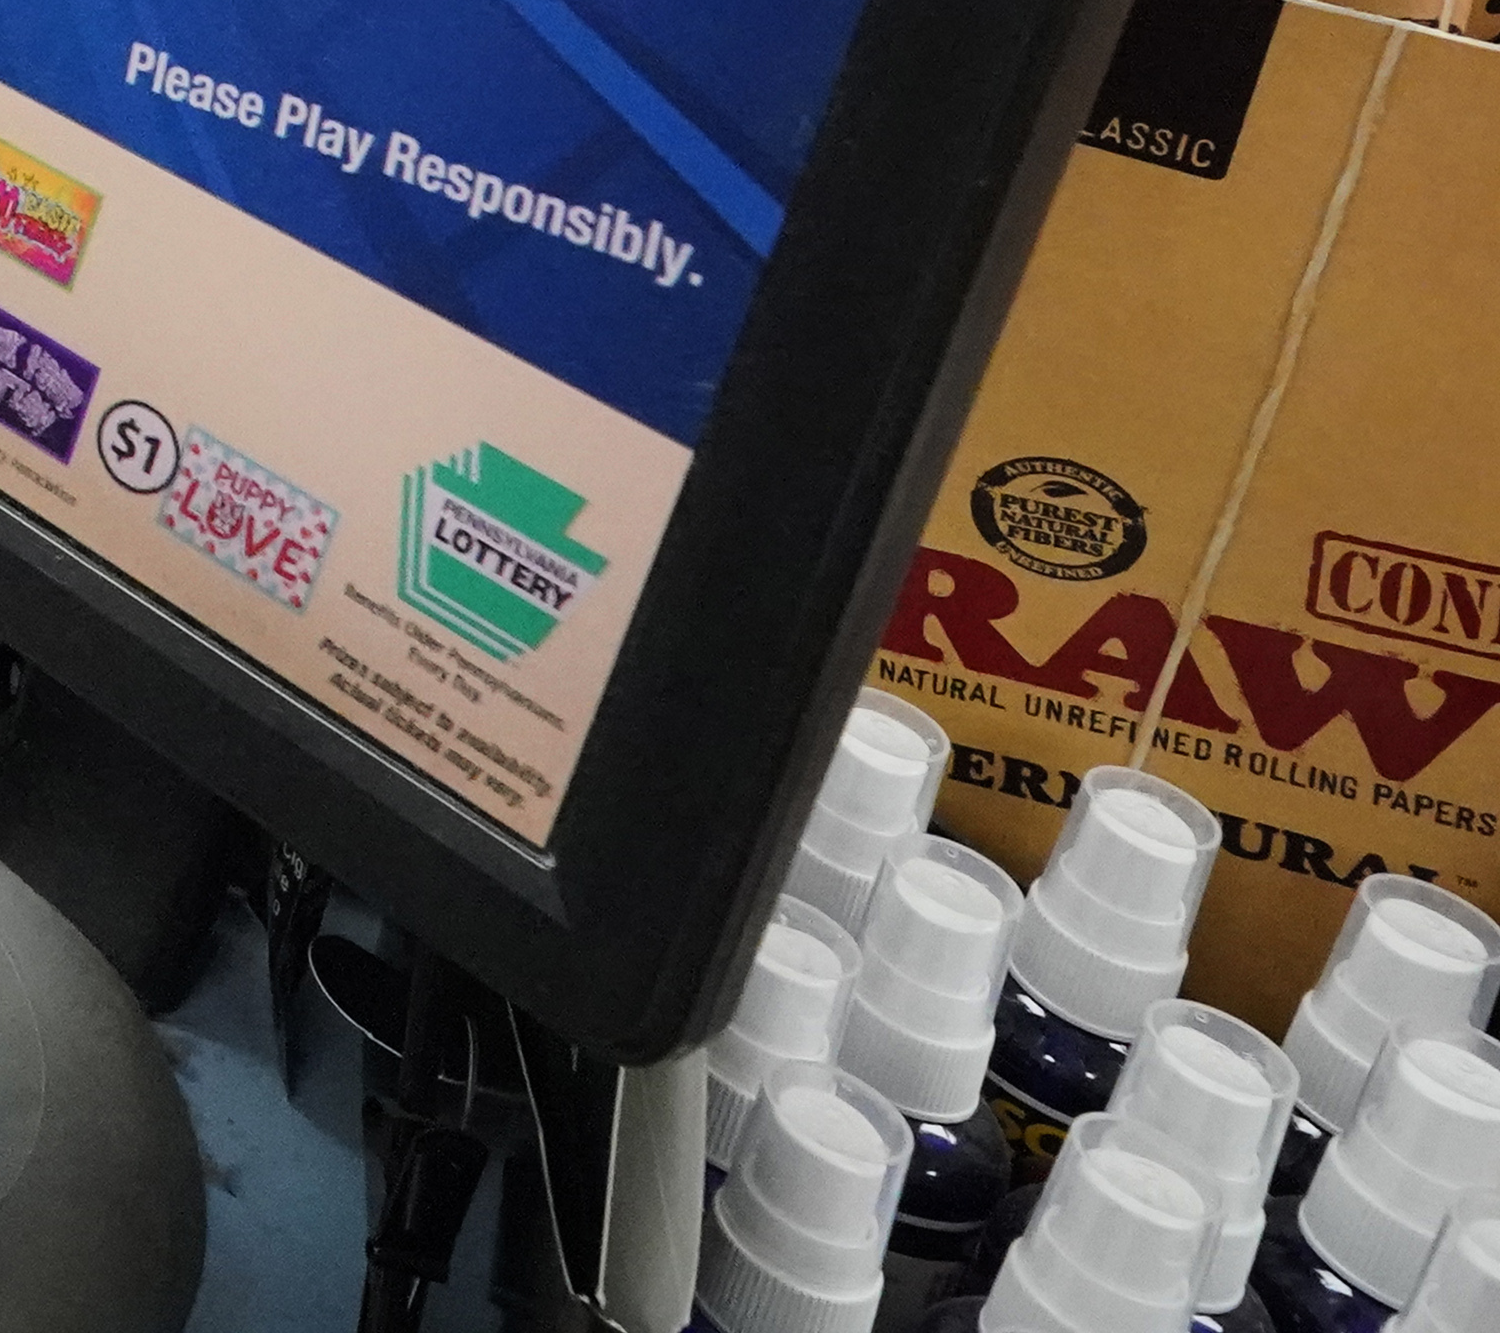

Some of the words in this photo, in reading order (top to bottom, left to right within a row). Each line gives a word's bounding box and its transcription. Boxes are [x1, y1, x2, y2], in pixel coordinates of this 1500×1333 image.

[126, 41, 265, 129] Please
[274, 91, 375, 174] Play
[384, 131, 705, 288] Responsibly.
[110, 417, 161, 477] $1
[214, 462, 293, 521] PUPPY
[1000, 493, 1119, 531] PUREST
[1004, 461, 1125, 503] AUTHENTIC
[179, 481, 300, 584] LOVE
[441, 495, 580, 587] PENNSYLVANIA
[1001, 511, 1114, 545] NATURAL
[1007, 525, 1104, 557] FIBERS
[434, 514, 574, 614] LOTTERY
[996, 541, 1103, 580] UNREFINED
[881, 546, 1500, 783] RAW
[879, 659, 1006, 711] NATURAL
[1025, 694, 1212, 762] UNREFINED
[1224, 742, 1359, 800] ROLLING
[1372, 782, 1497, 837] PAPERS
